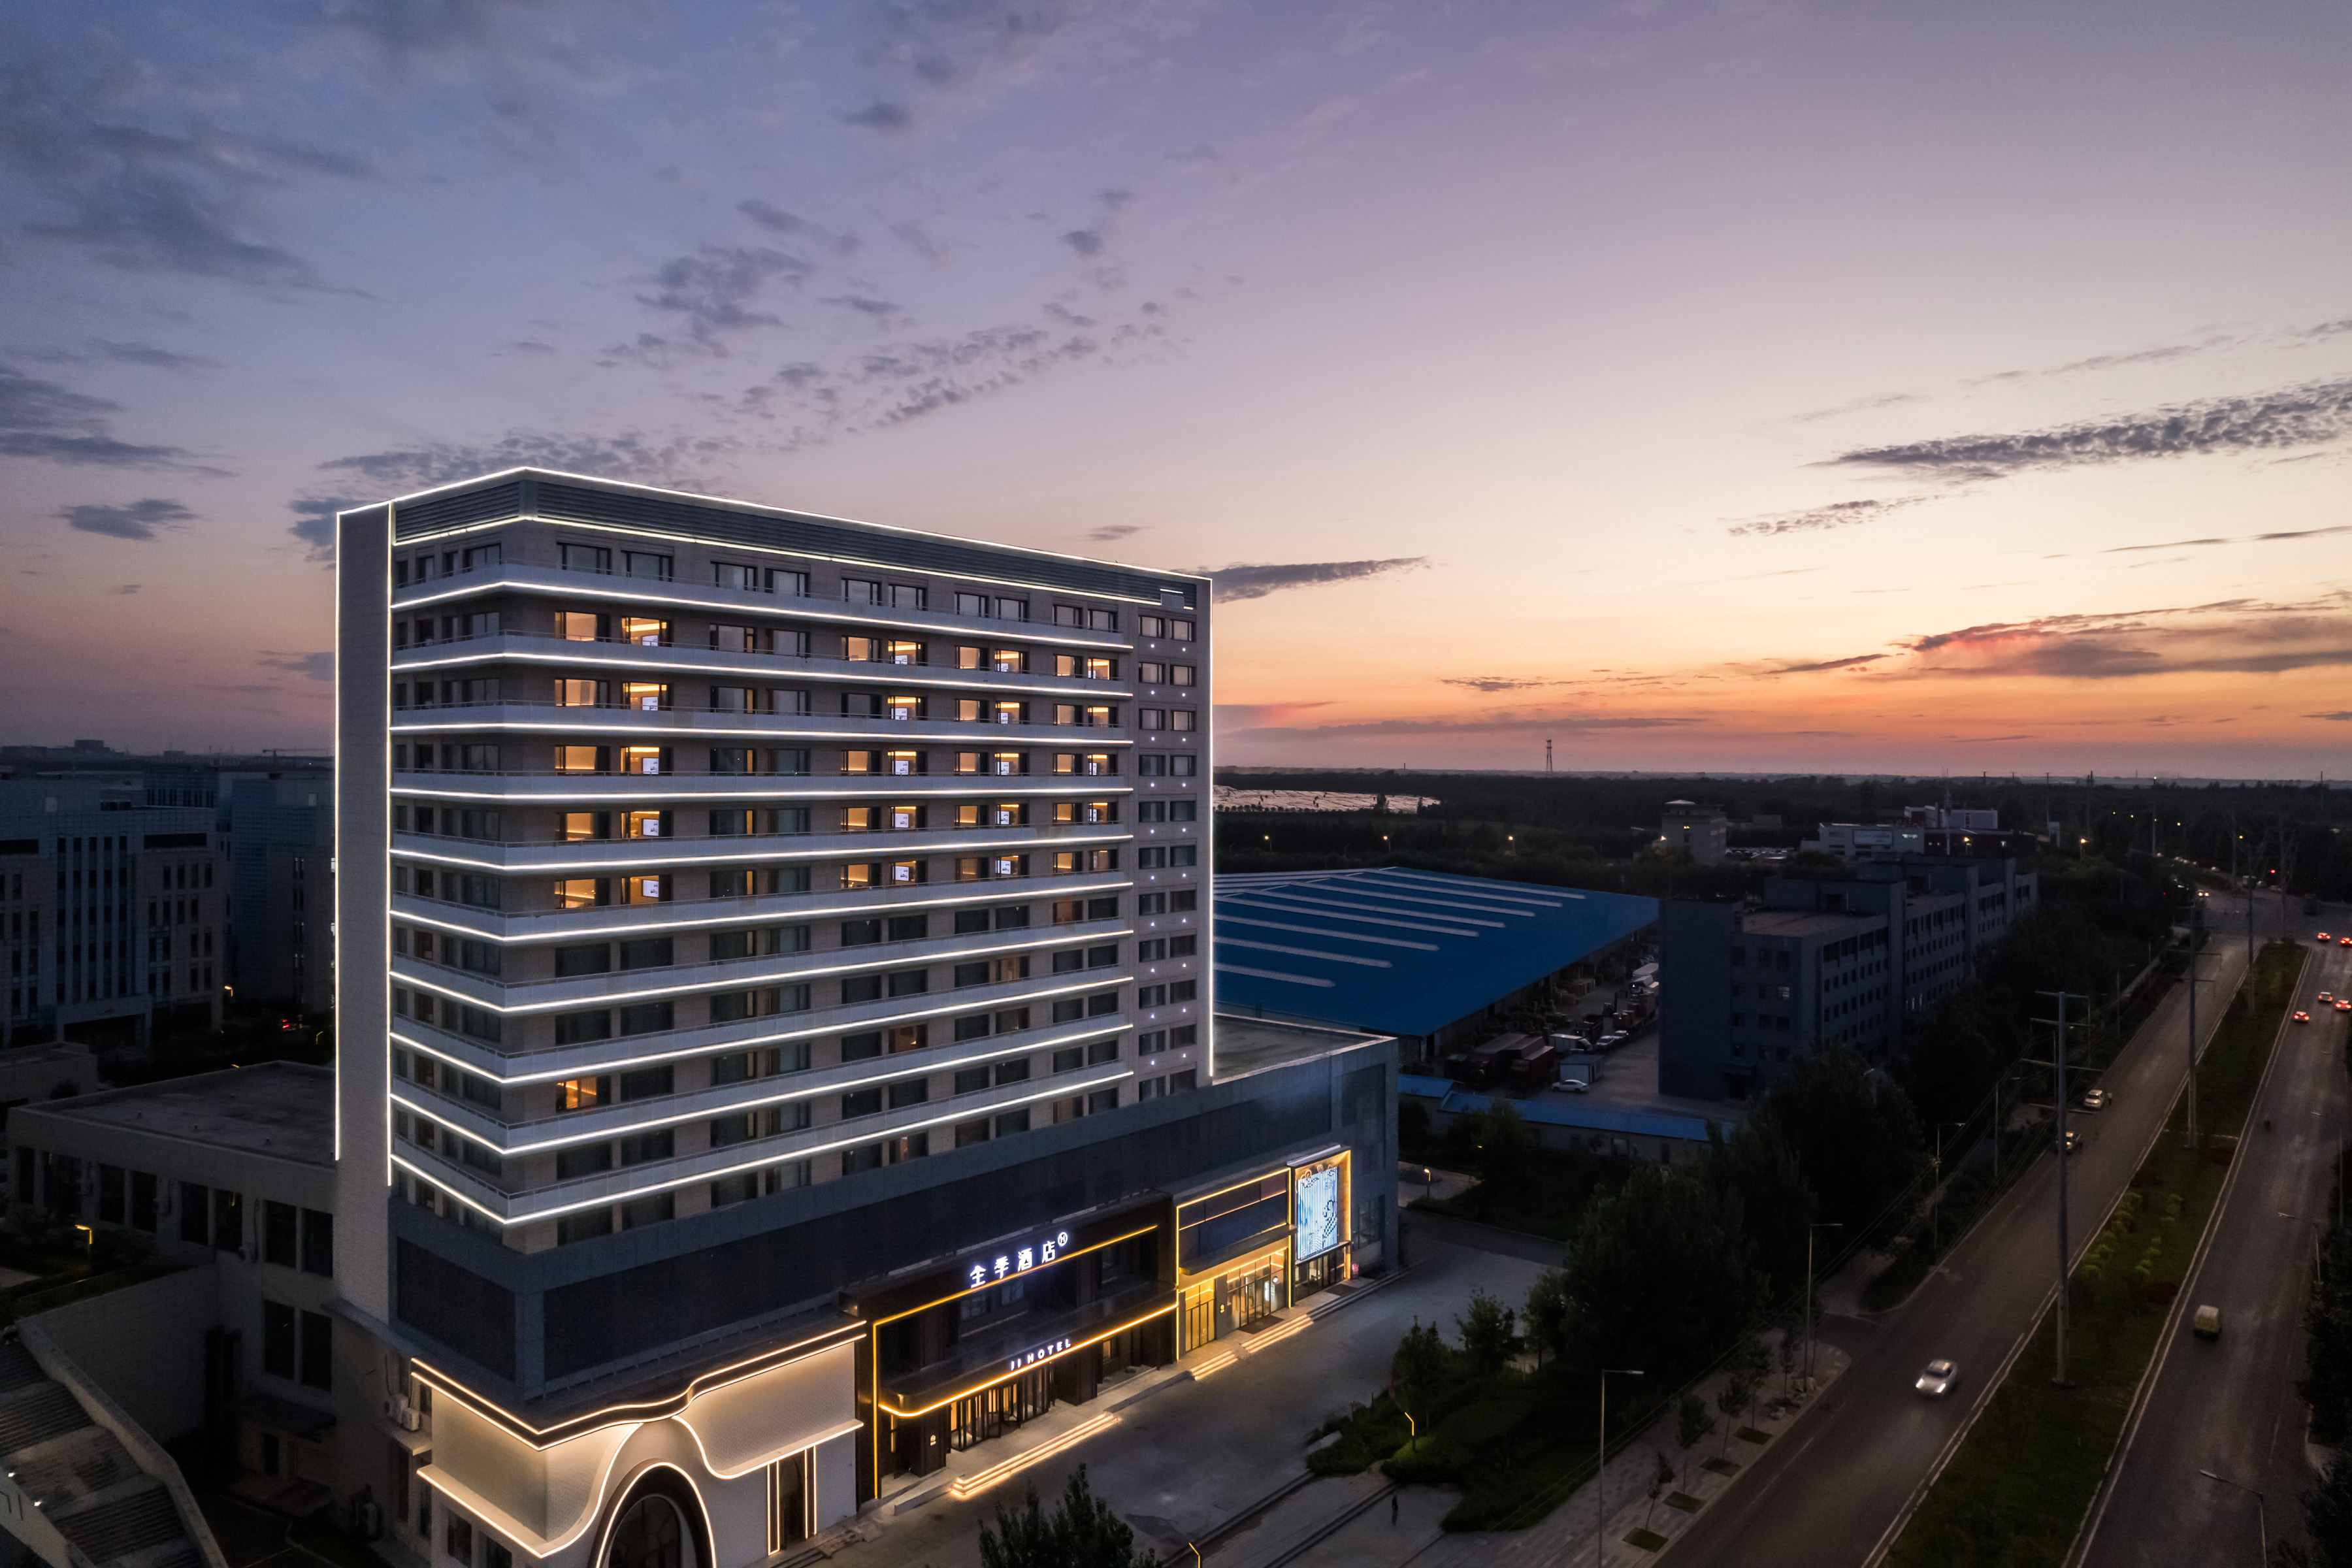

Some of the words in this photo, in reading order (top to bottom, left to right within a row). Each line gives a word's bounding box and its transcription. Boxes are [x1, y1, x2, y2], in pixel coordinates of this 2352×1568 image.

[970, 1241, 1056, 1288] 全季酒店
[1027, 1339, 1071, 1364] HOTEL
